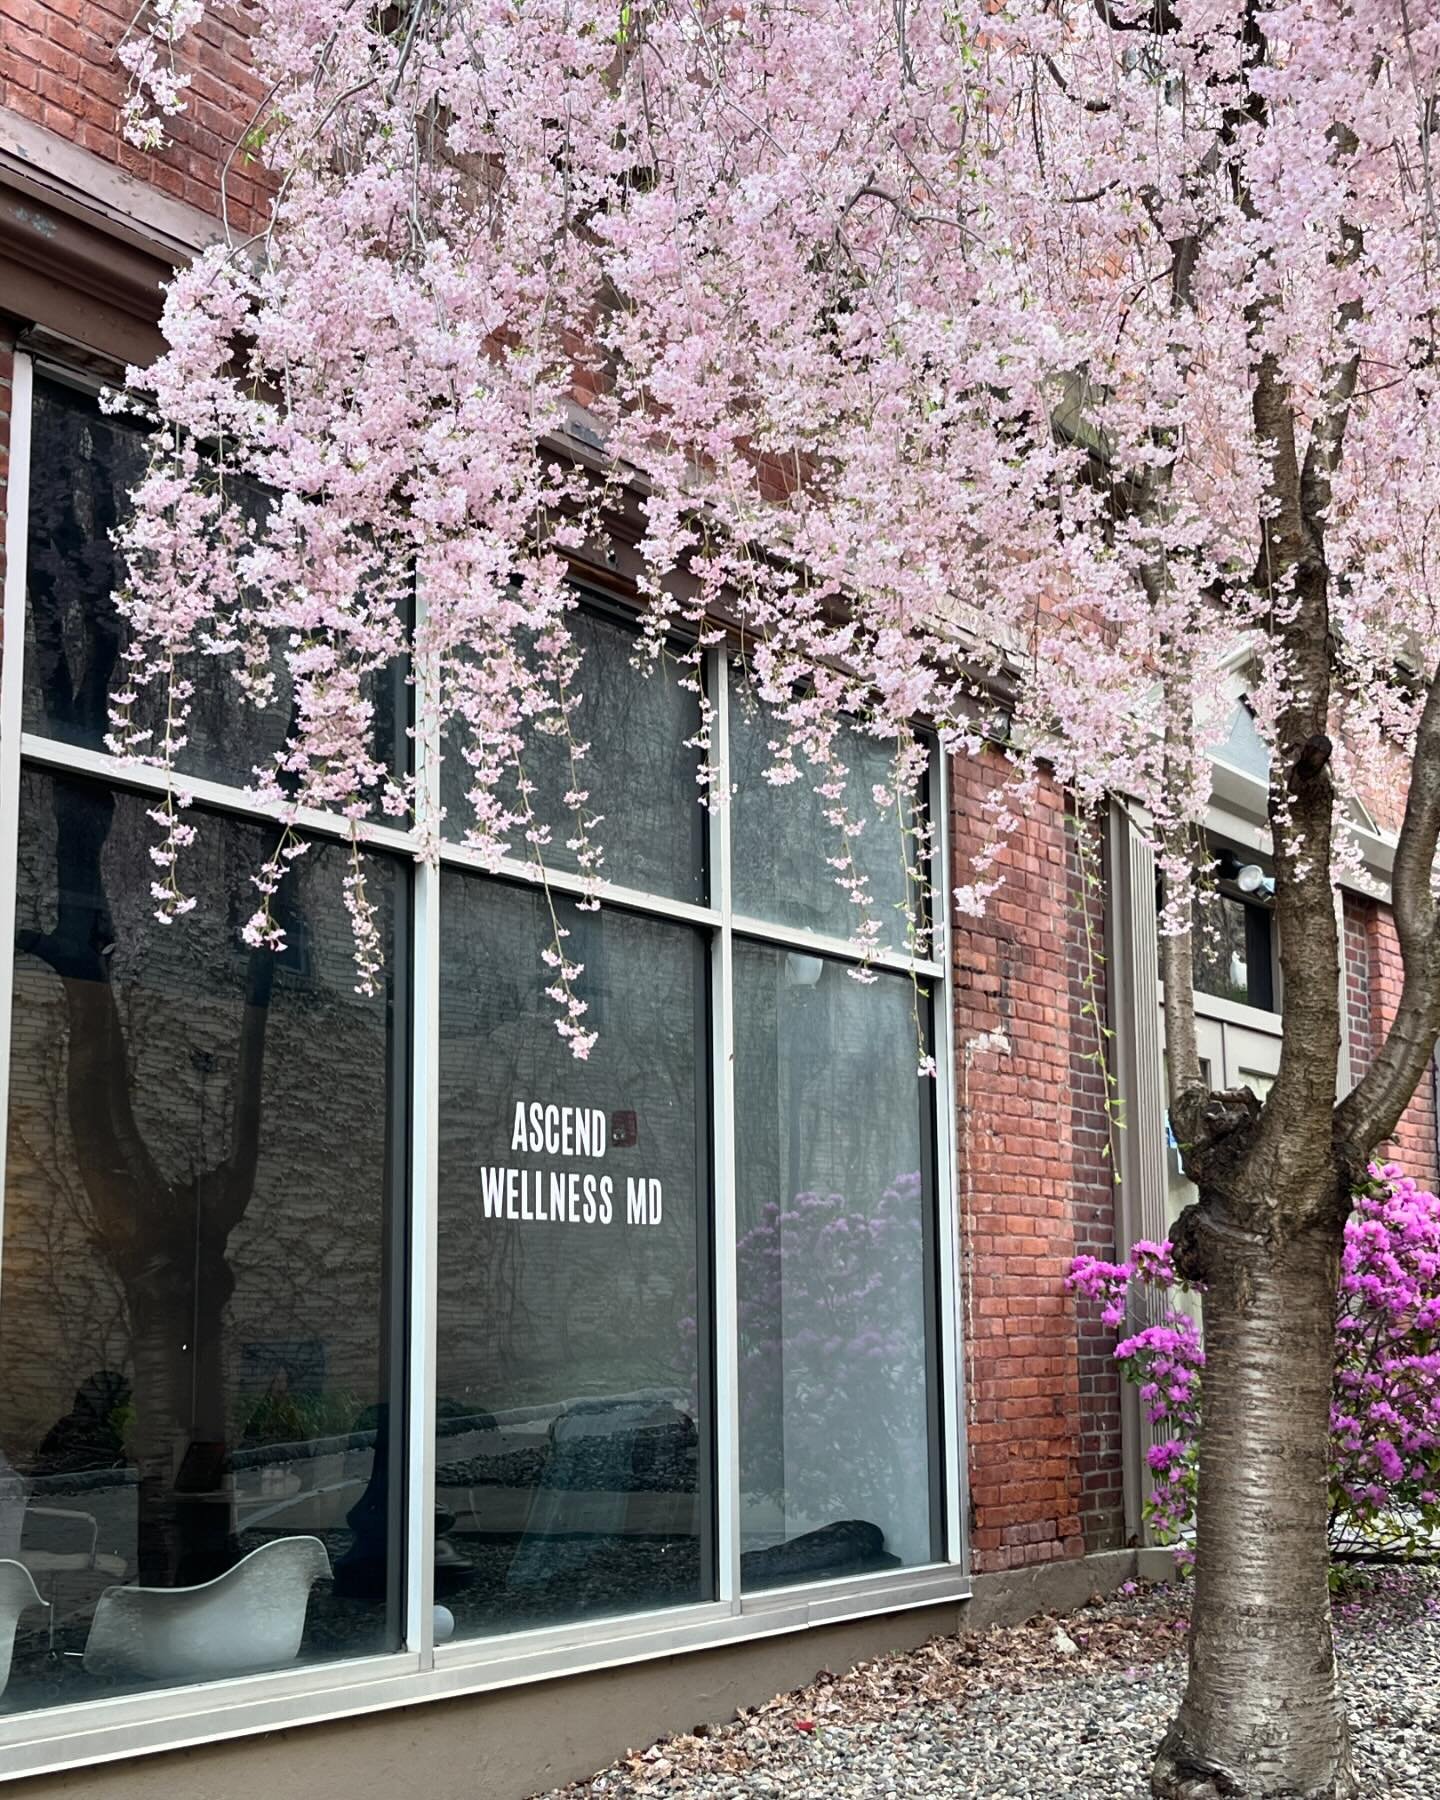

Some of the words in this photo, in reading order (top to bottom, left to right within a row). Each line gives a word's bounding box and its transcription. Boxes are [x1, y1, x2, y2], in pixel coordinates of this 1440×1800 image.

[511, 1101, 606, 1158] ASCEND
[480, 1166, 613, 1225] WELLNESS
[626, 1177, 663, 1225] MD
